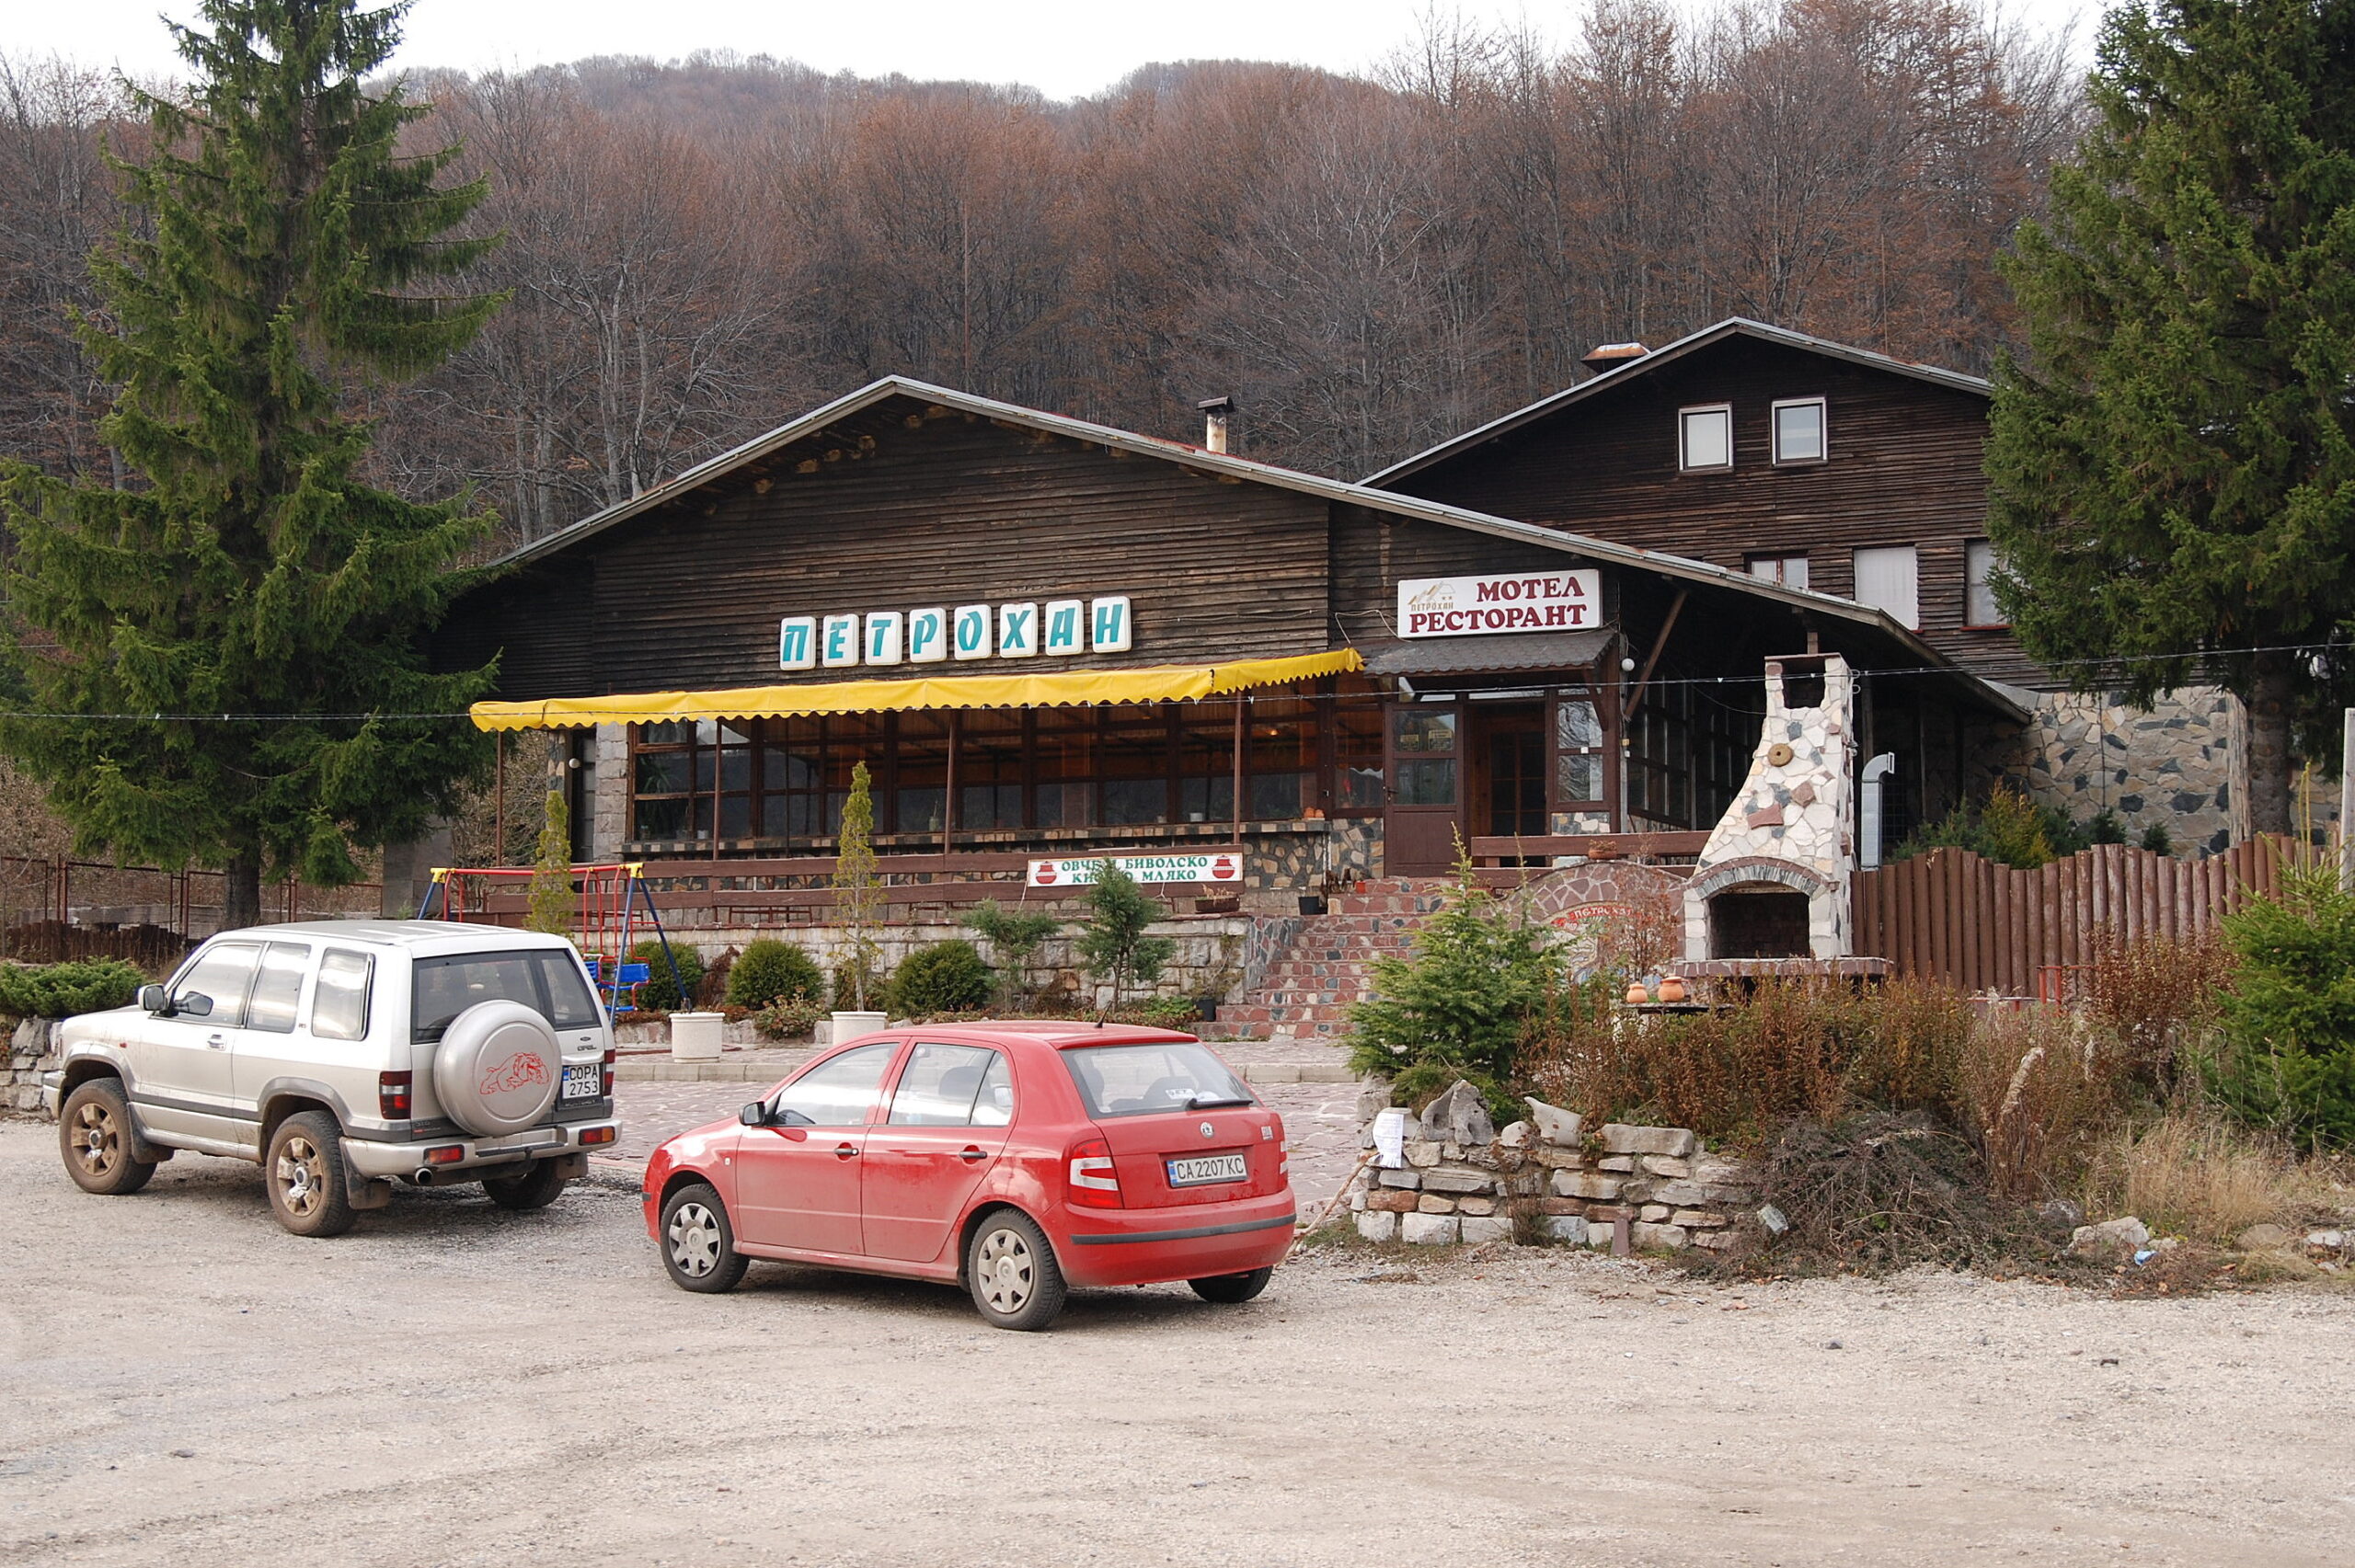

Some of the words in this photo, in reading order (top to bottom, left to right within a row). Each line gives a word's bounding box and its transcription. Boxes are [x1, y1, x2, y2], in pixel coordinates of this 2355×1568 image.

[1476, 576, 1585, 602] МОТЕЛ
[1411, 601, 1453, 611] ПЕТРОХАН
[1409, 603, 1587, 634] РЕСТОРАНТ
[782, 603, 1123, 662] ПЕТРОХАН
[1125, 856, 1208, 869] БИВОЛСКО
[1142, 869, 1197, 882] МЛЯКО
[569, 1081, 598, 1096] 2753
